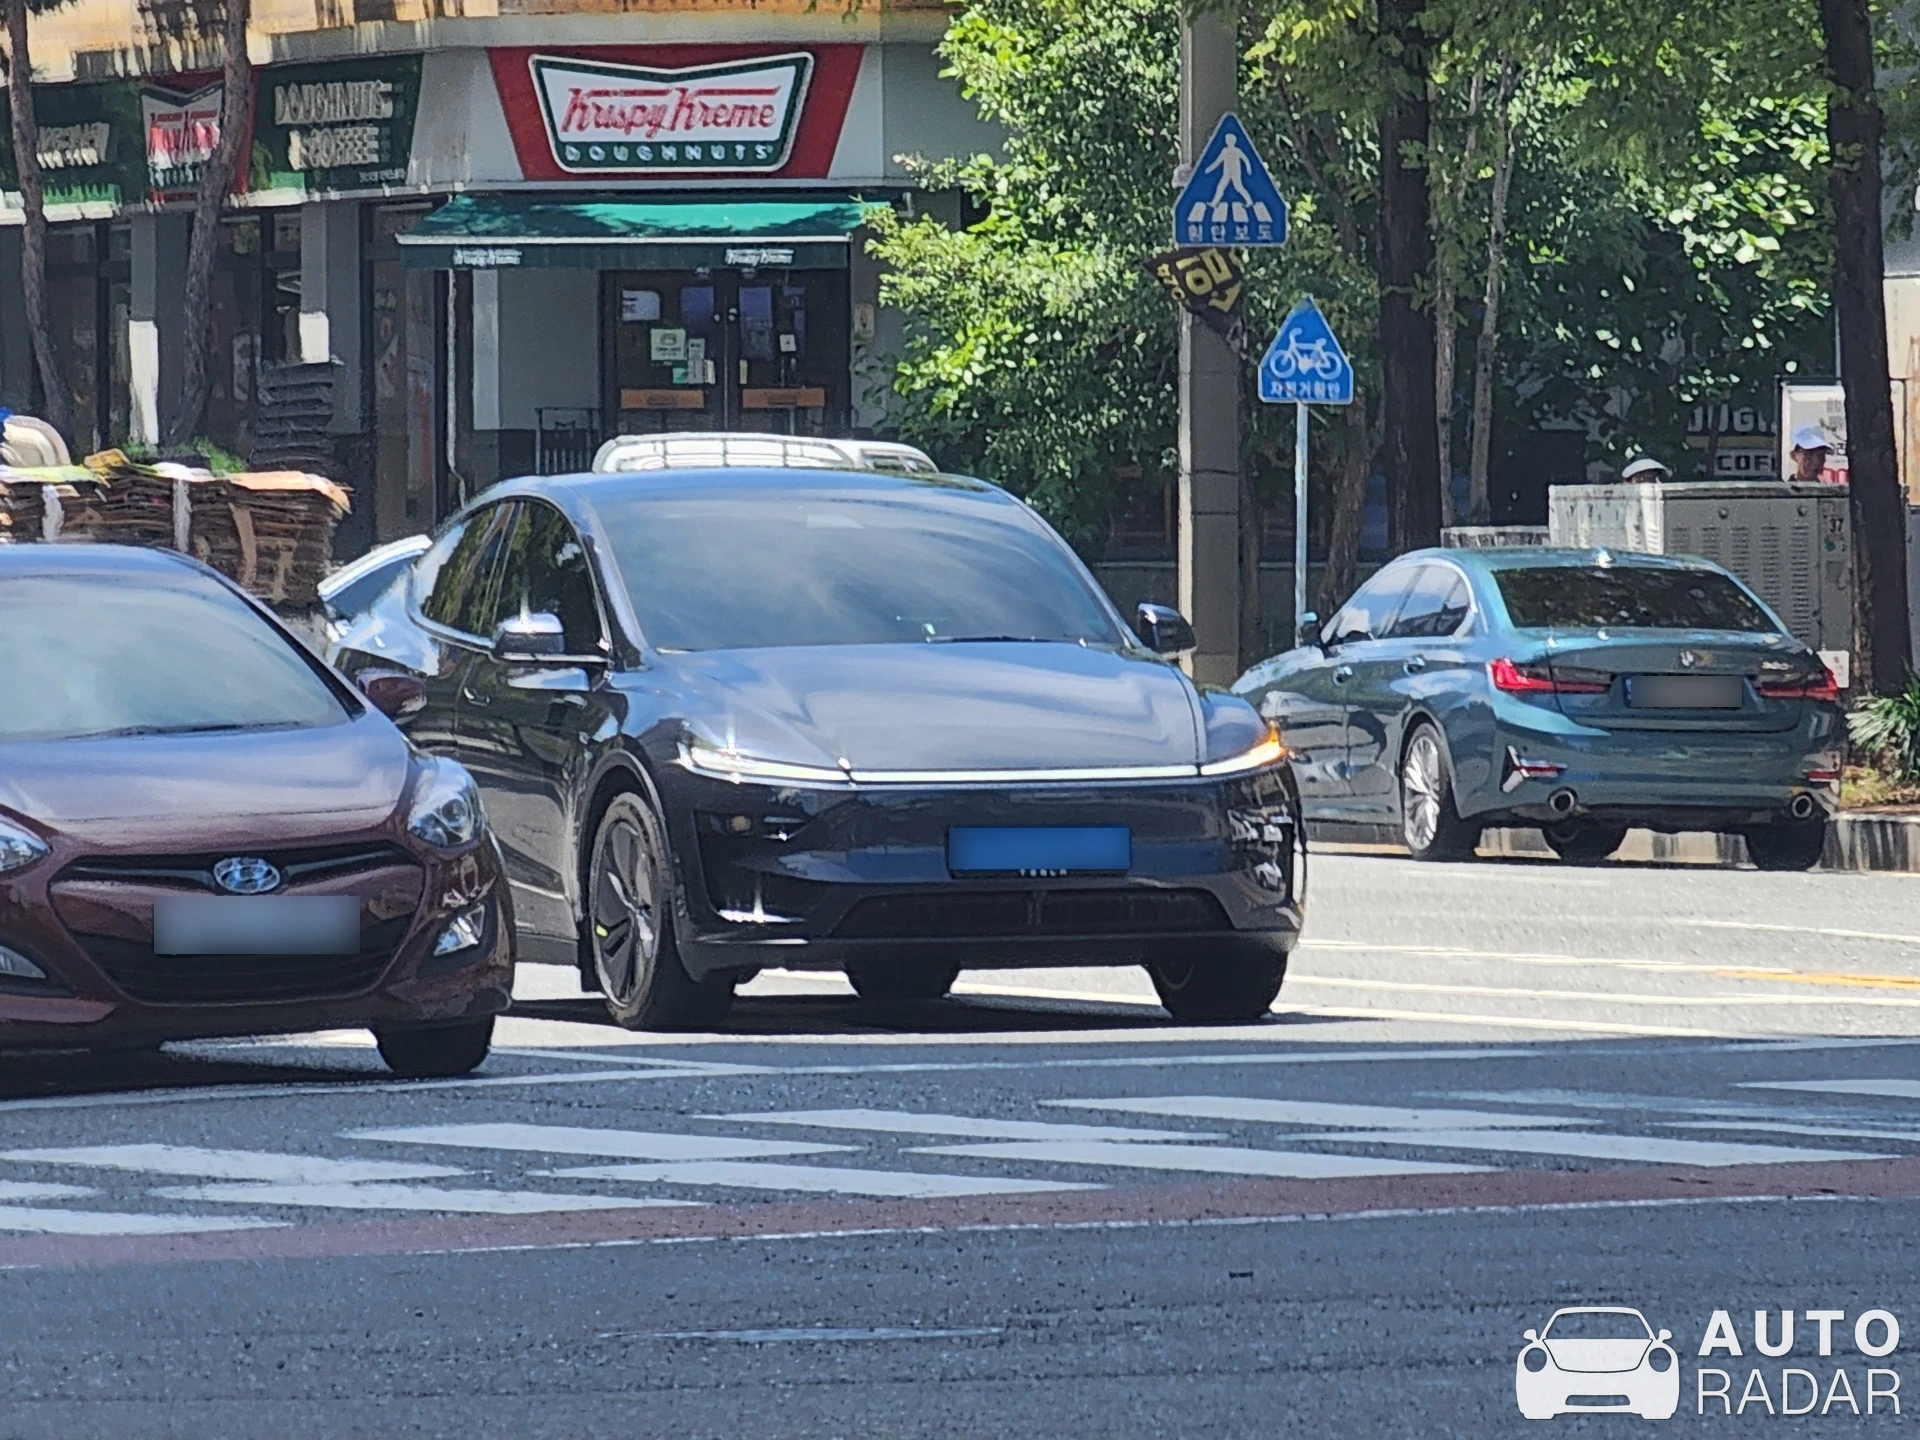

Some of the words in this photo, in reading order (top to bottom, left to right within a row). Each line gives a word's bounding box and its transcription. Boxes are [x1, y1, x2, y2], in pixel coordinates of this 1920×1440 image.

[560, 87, 671, 139] Krispy
[669, 85, 782, 131] Kreme
[565, 144, 775, 161] DOUGHNUTS
